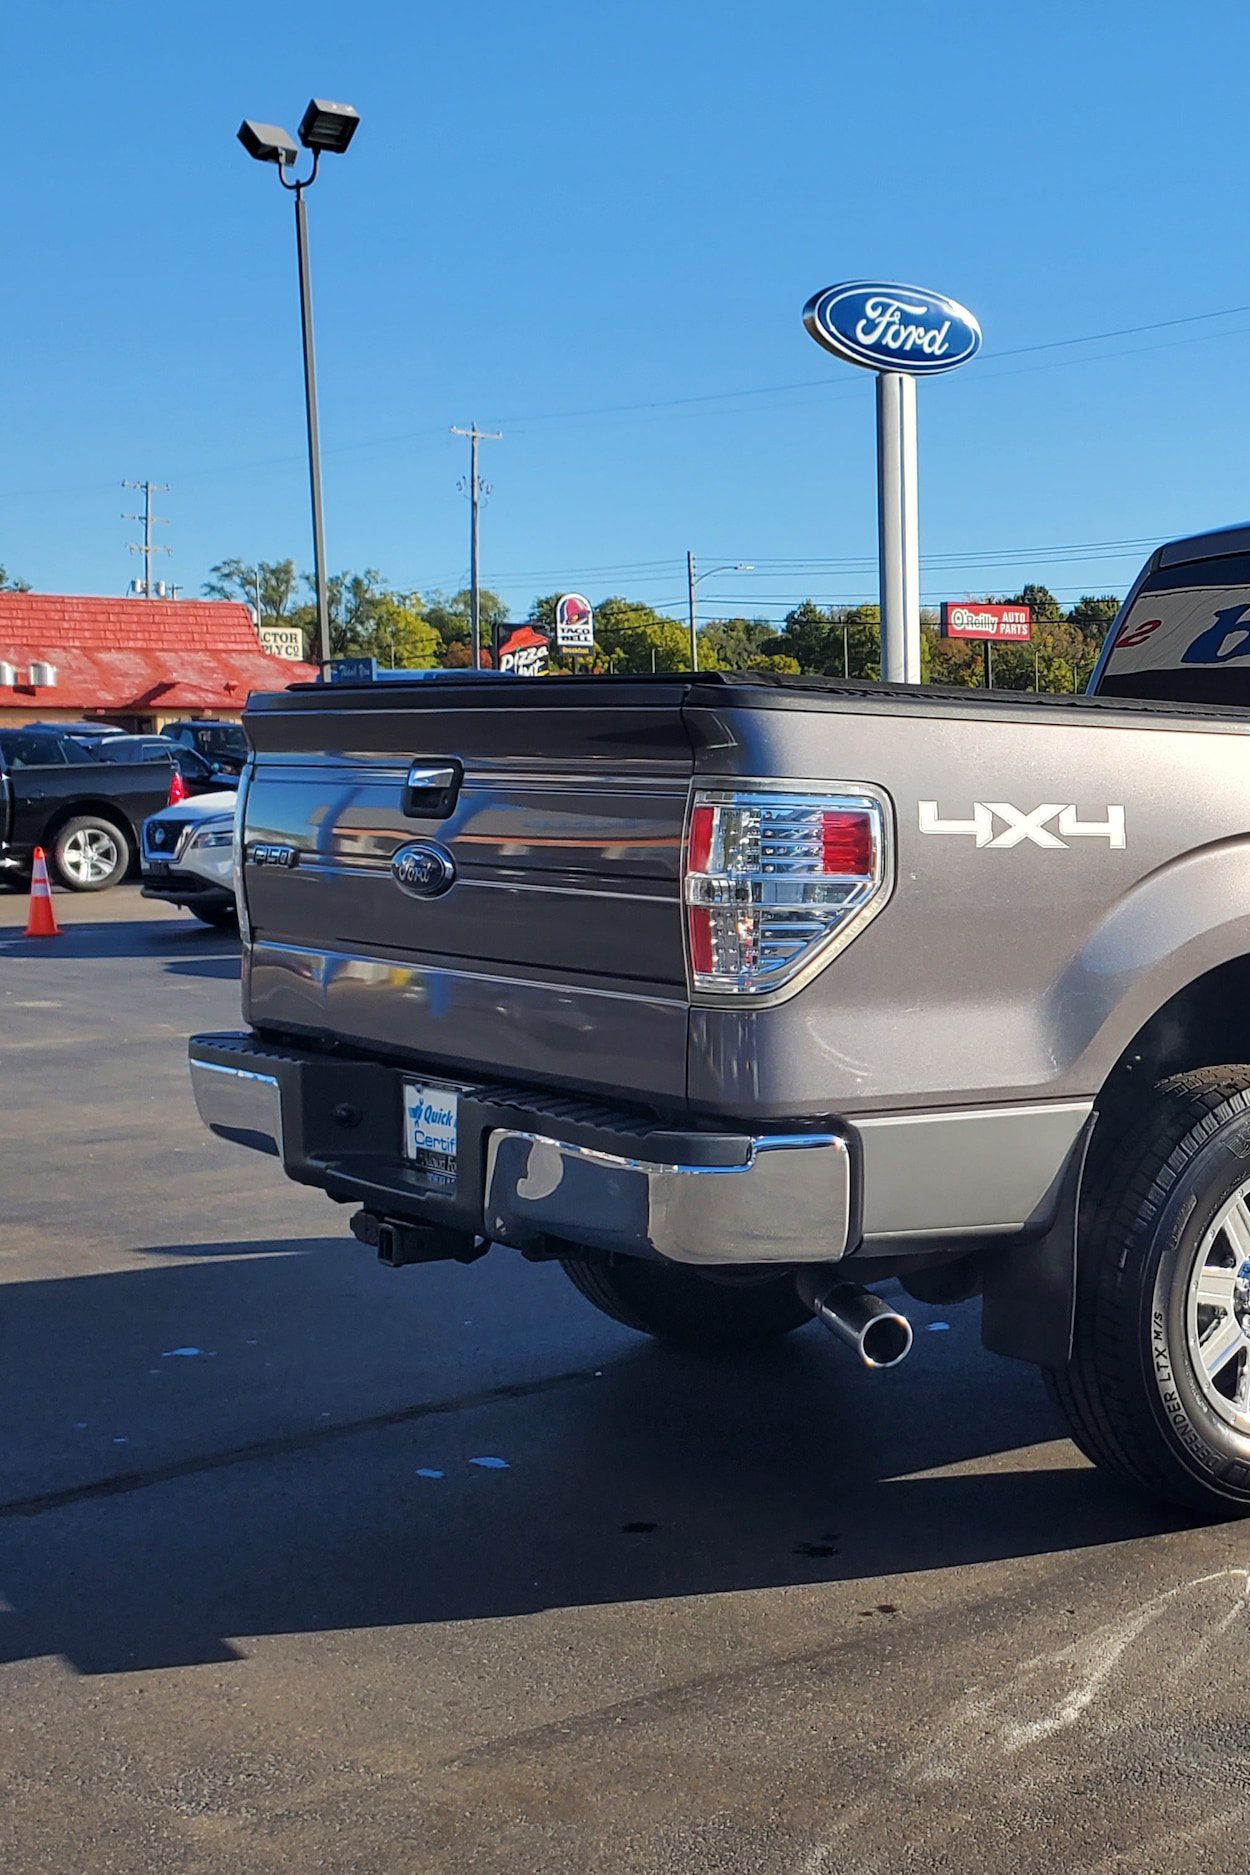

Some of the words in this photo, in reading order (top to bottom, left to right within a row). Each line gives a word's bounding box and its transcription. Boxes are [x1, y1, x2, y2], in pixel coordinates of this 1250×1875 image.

[856, 297, 951, 355] Ford
[953, 609, 998, 634] O'Reilly
[1000, 624, 1028, 635] PARTS
[1003, 612, 1025, 623] AUTO
[260, 631, 299, 643] CTOR
[500, 646, 549, 673] Pizza
[399, 853, 433, 882] Ford
[424, 1105, 453, 1127] Quick
[1152, 1311, 1164, 1341] M/S
[1154, 1347, 1172, 1383] LTX
[1163, 1390, 1219, 1468] DEFENDER
